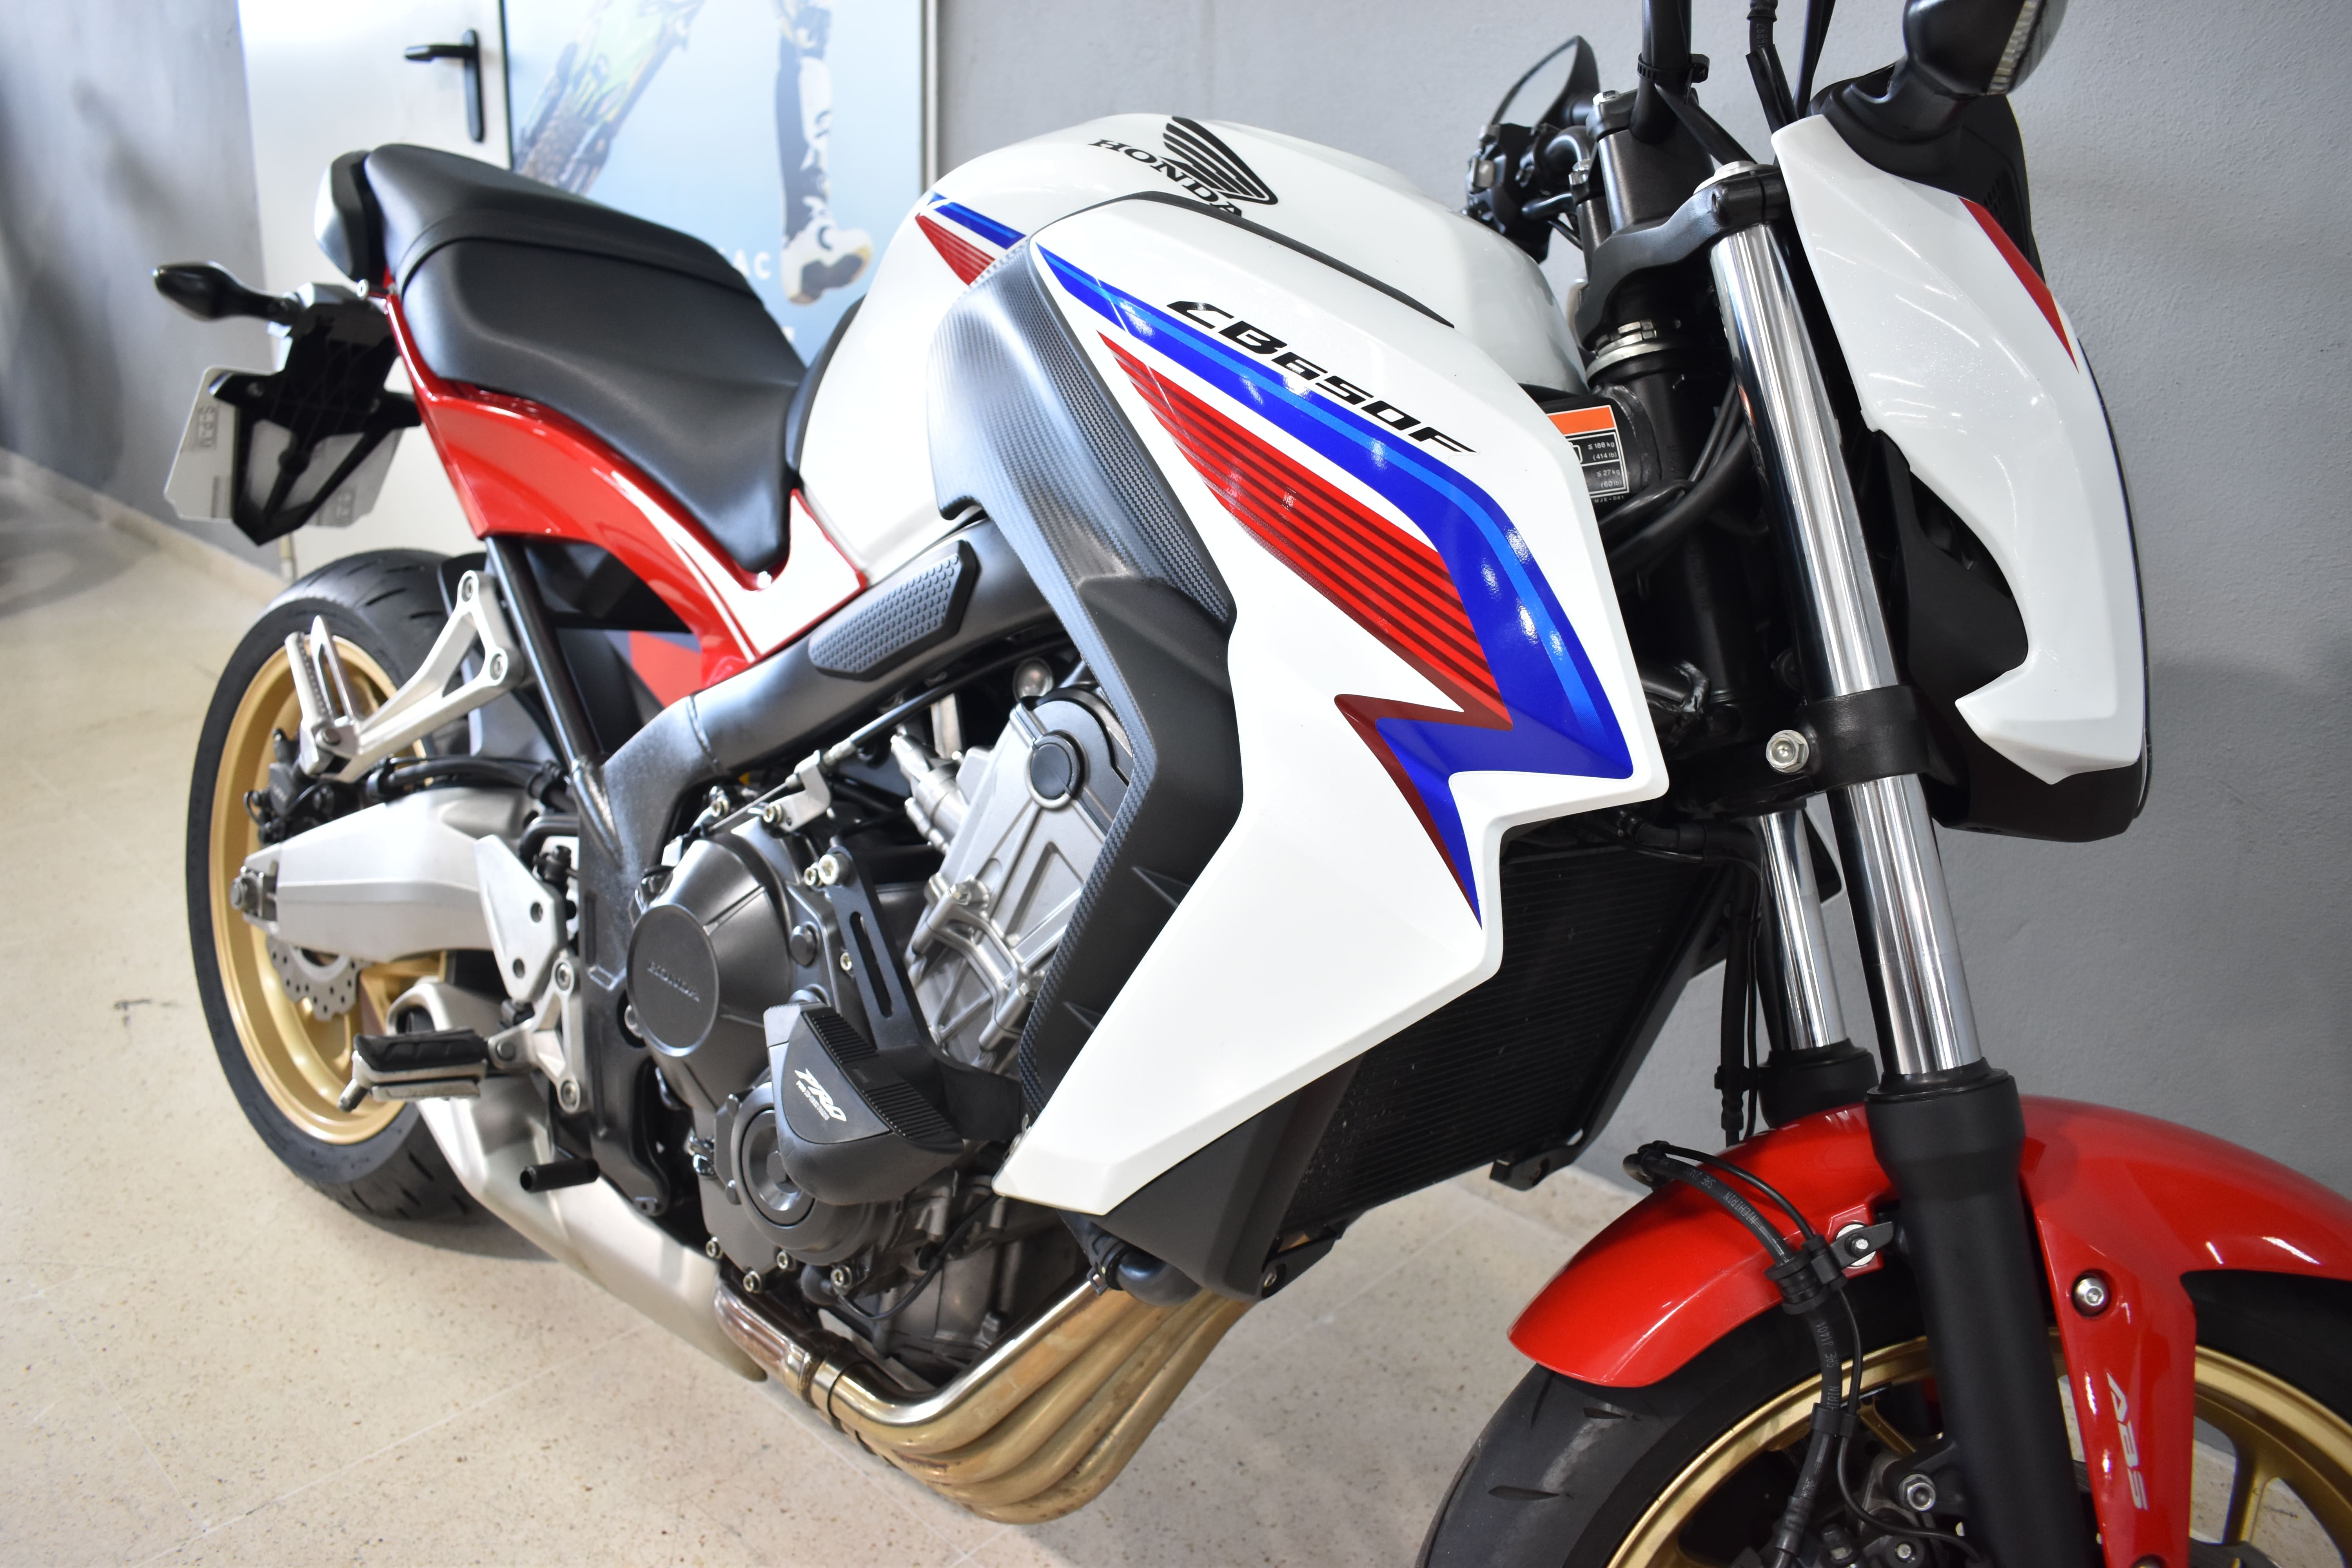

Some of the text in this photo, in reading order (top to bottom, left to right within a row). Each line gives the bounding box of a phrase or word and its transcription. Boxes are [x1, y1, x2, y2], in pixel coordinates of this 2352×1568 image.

[1088, 139, 1242, 217] HONDA
[1166, 301, 1478, 455] CB650F
[646, 959, 701, 1003] HONDA
[794, 1068, 847, 1122] PRO
[1700, 1175, 1716, 1189] SAE
[1723, 1191, 1760, 1225] NICHIRIN
[1815, 1321, 1834, 1346] J1401
[1824, 1351, 1839, 1368] SAE
[2106, 1372, 2148, 1510] ABS
